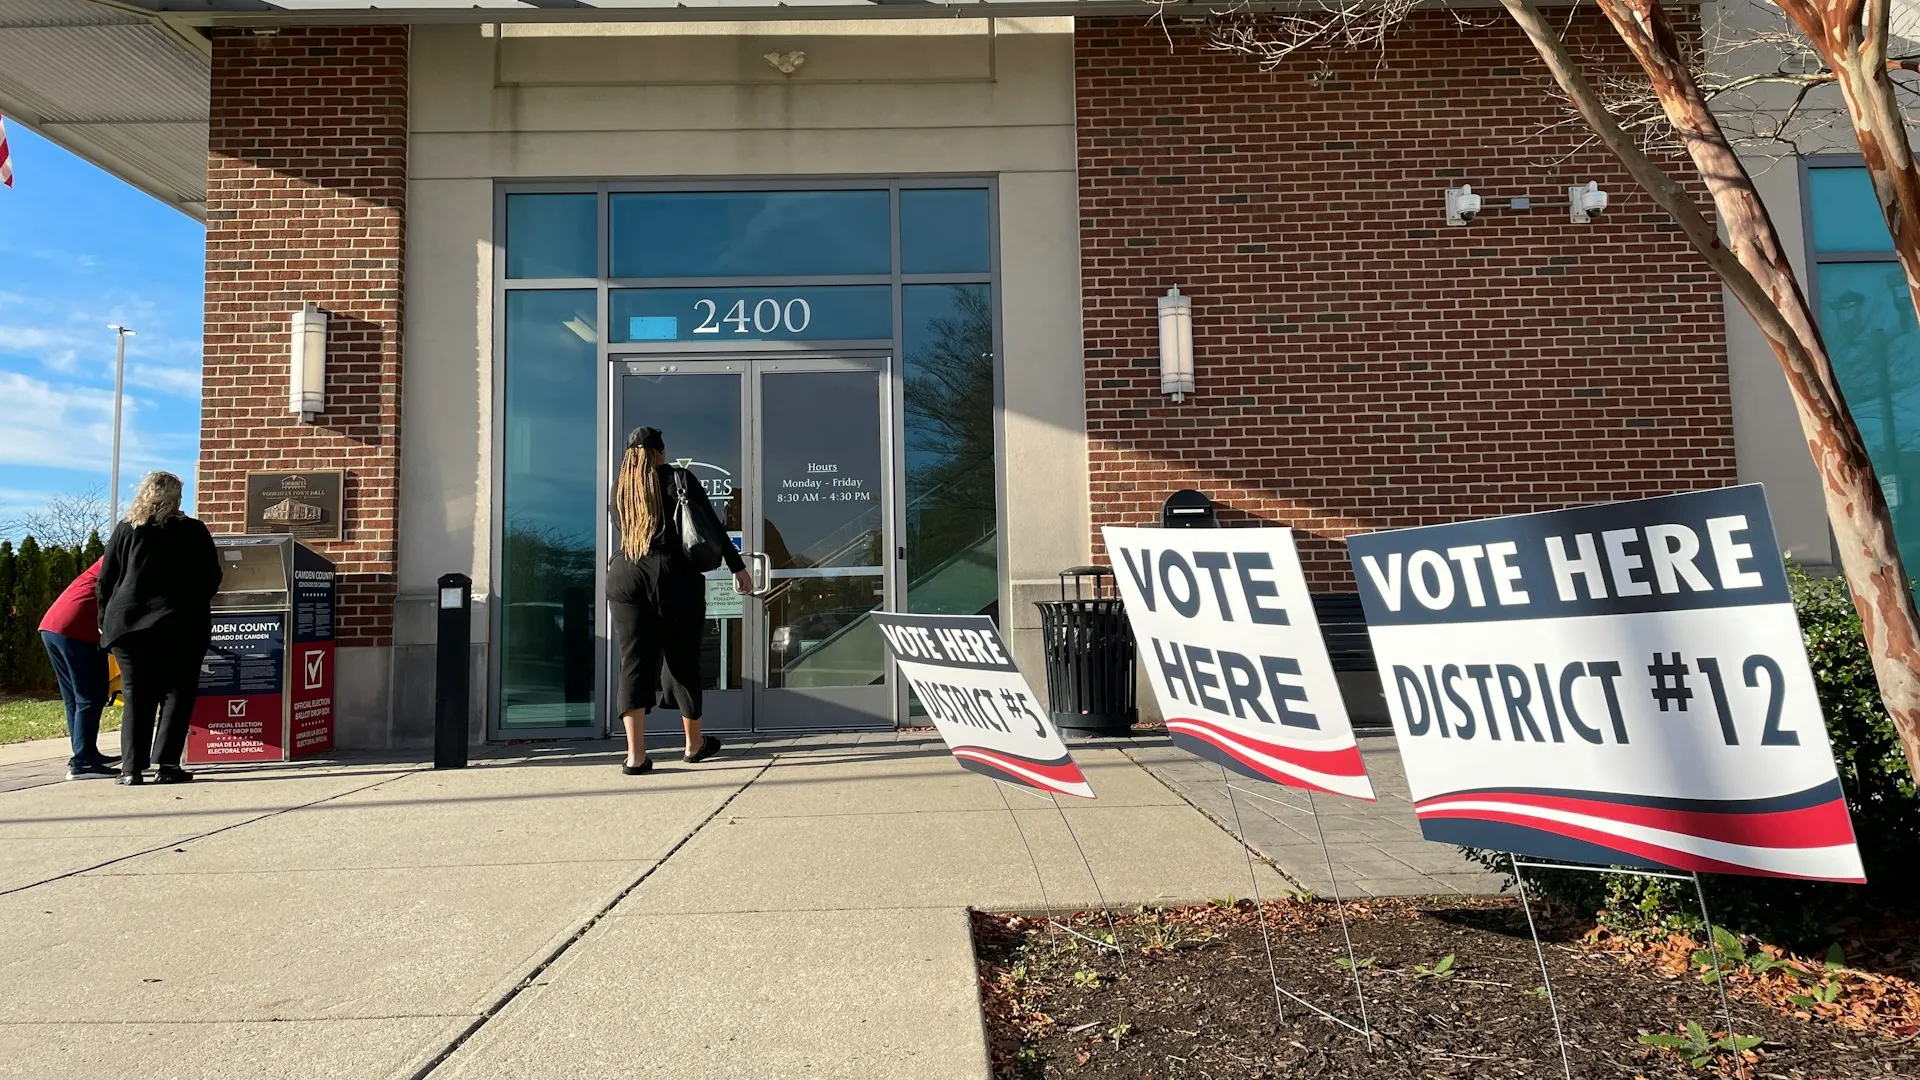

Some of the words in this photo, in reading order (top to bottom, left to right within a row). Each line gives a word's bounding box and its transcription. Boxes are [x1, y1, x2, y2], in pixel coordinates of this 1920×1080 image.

[692, 298, 811, 333] 2400
[782, 479, 822, 489] Monday
[832, 478, 863, 488] Friday
[807, 463, 838, 472] Hours
[777, 493, 799, 502] 8:30
[801, 493, 819, 502] AM
[829, 492, 852, 501] 4:30
[854, 491, 871, 501] PM
[294, 570, 315, 580] CAMDEN
[1361, 540, 1531, 612] VOTE
[1545, 515, 1764, 602] HERE
[1119, 547, 1291, 626] VOTE
[238, 622, 280, 632] COUNTY
[879, 624, 944, 660] VOTE
[934, 628, 1009, 665] HERE
[1151, 637, 1321, 731] HERE
[1392, 661, 1630, 746] DISTRICT
[1647, 651, 1800, 747] #12
[913, 679, 1012, 734] DISTRICT
[1000, 687, 1048, 739] #5
